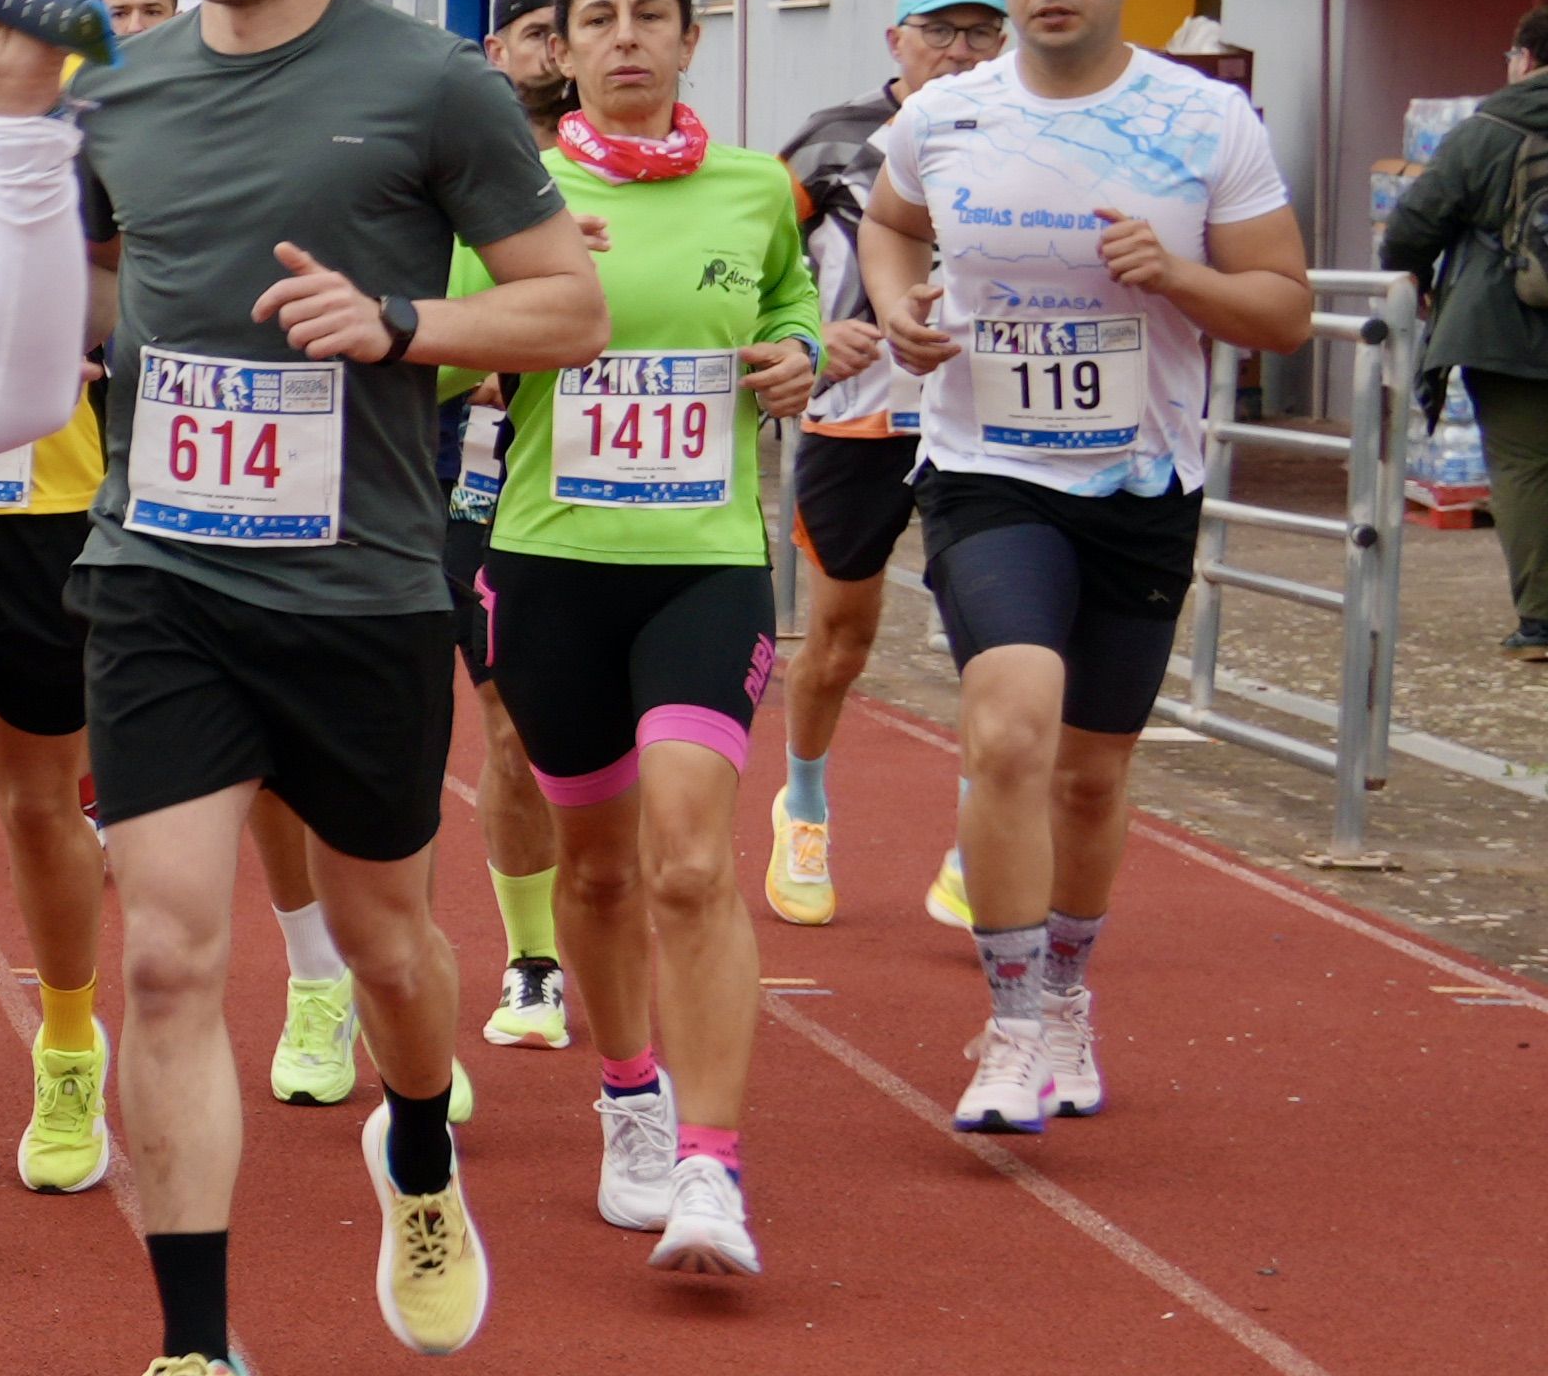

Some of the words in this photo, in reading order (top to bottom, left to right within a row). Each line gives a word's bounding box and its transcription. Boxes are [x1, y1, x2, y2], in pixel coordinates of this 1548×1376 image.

[958, 207, 1013, 226] LEGUAS
[1020, 210, 1076, 230] CIUDAD
[1027, 295, 1103, 310] ABASA
[157, 360, 216, 408] 21K
[1011, 359, 1101, 411] 119
[168, 414, 281, 489] 614
[581, 402, 707, 460] 1419
